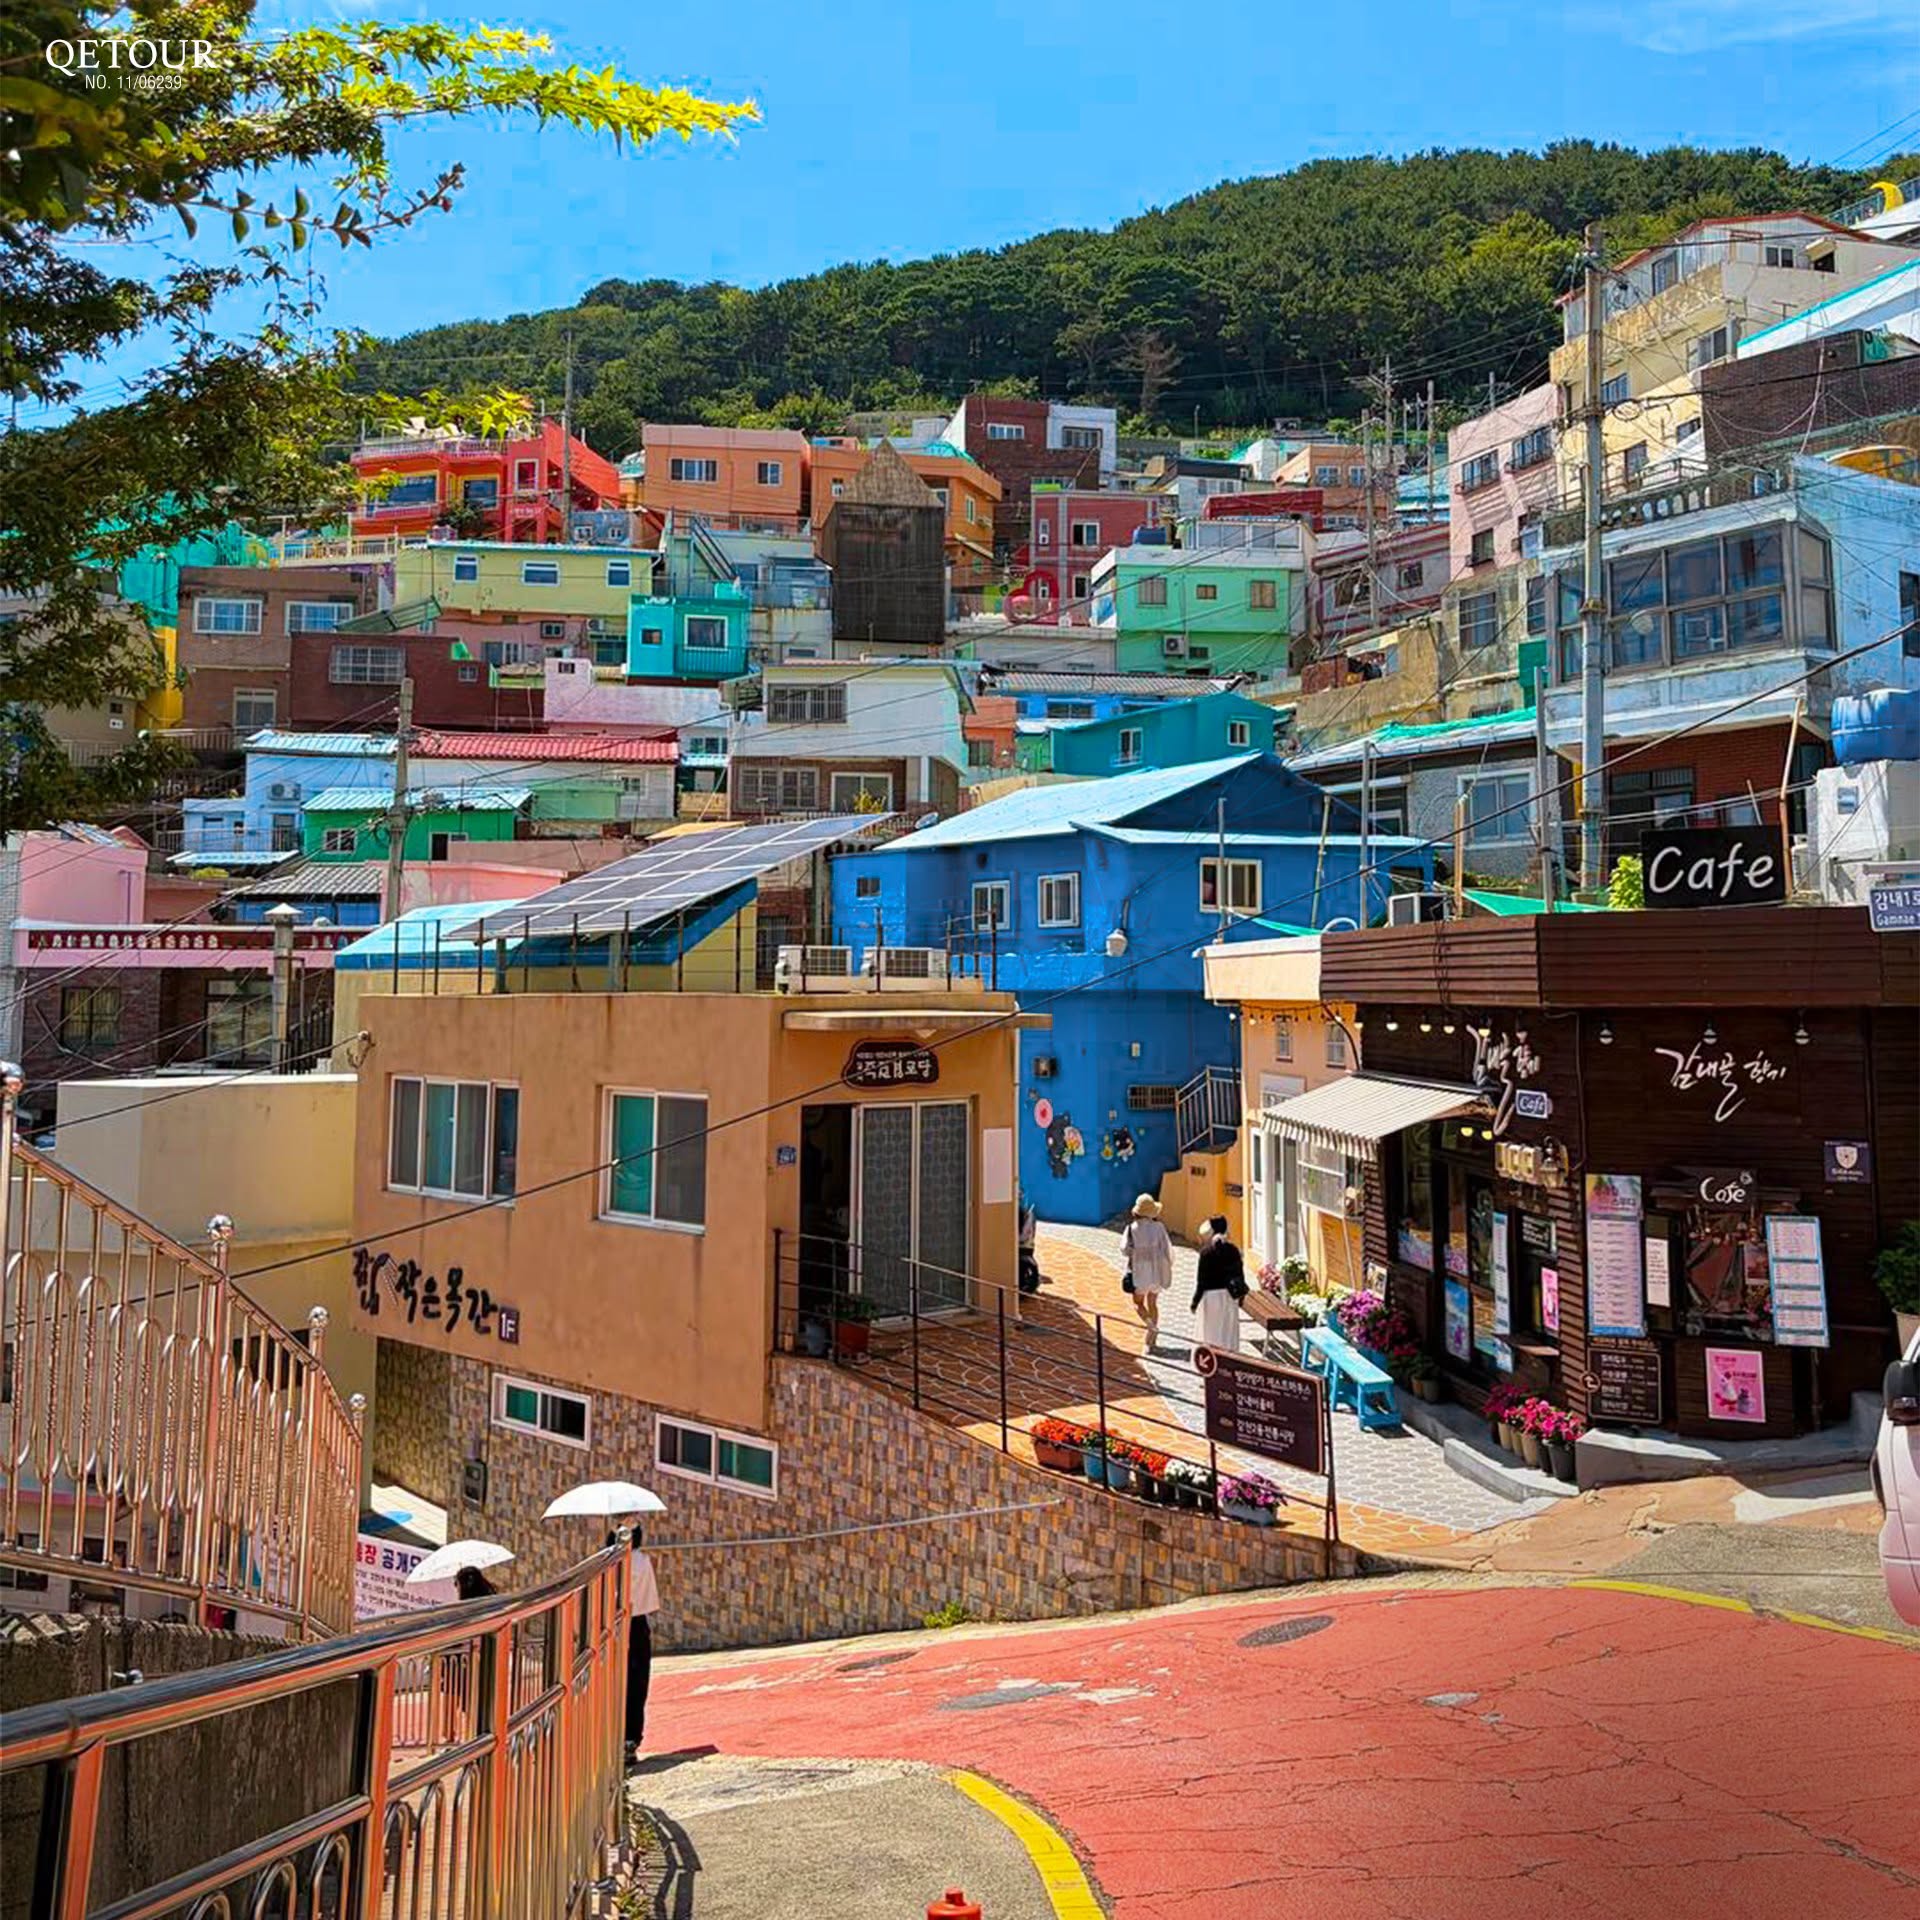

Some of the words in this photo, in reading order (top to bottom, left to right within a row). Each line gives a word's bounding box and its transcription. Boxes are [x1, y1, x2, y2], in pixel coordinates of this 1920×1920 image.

[1649, 842, 1774, 898] Cafe
[1654, 1042, 1746, 1123] 감내골
[1743, 1050, 1787, 1084] 향기
[1699, 1176, 1746, 1204] Cafe
[501, 1313, 516, 1339] 1F
